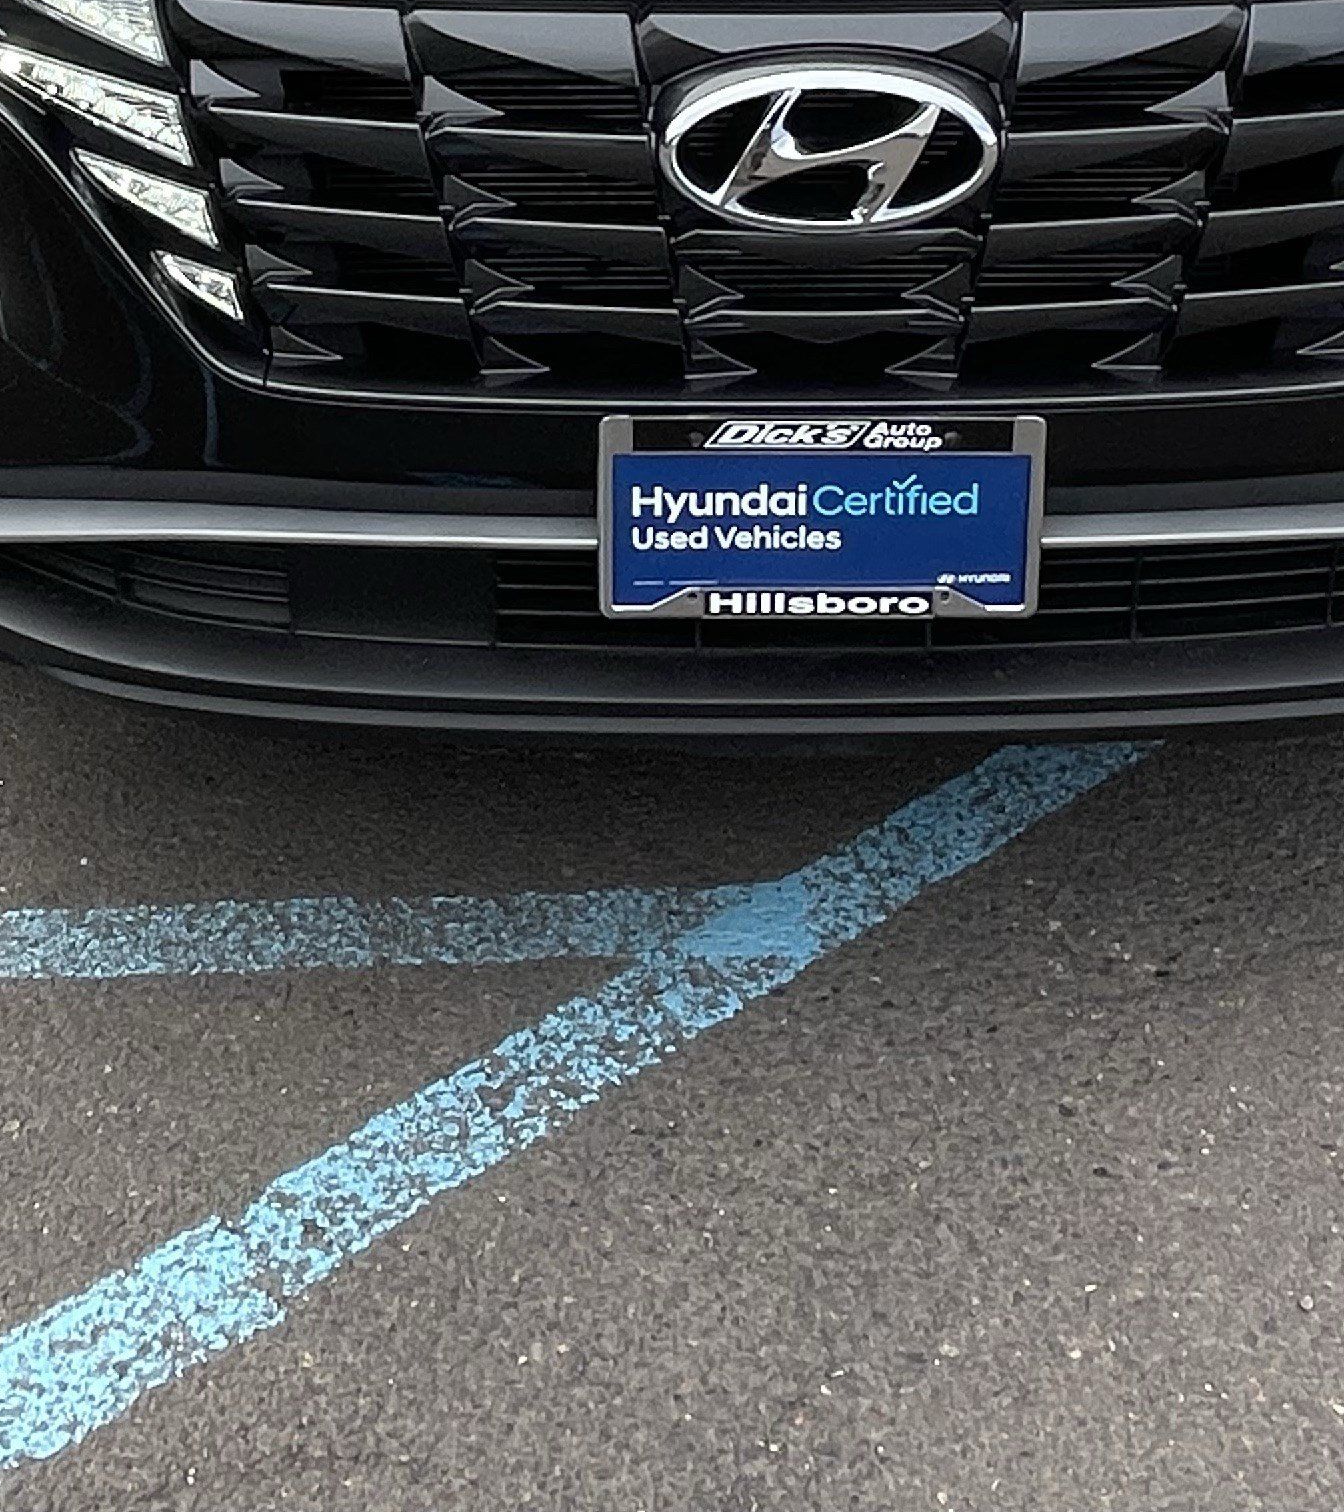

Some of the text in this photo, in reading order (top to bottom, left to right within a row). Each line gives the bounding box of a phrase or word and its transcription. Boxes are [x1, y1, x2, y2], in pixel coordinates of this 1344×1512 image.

[870, 421, 933, 437] Auto
[862, 434, 943, 452] Group
[631, 475, 980, 524] Hyundai Certified
[631, 524, 843, 550] Used Vehicles
[708, 591, 930, 615] Hillsboro
